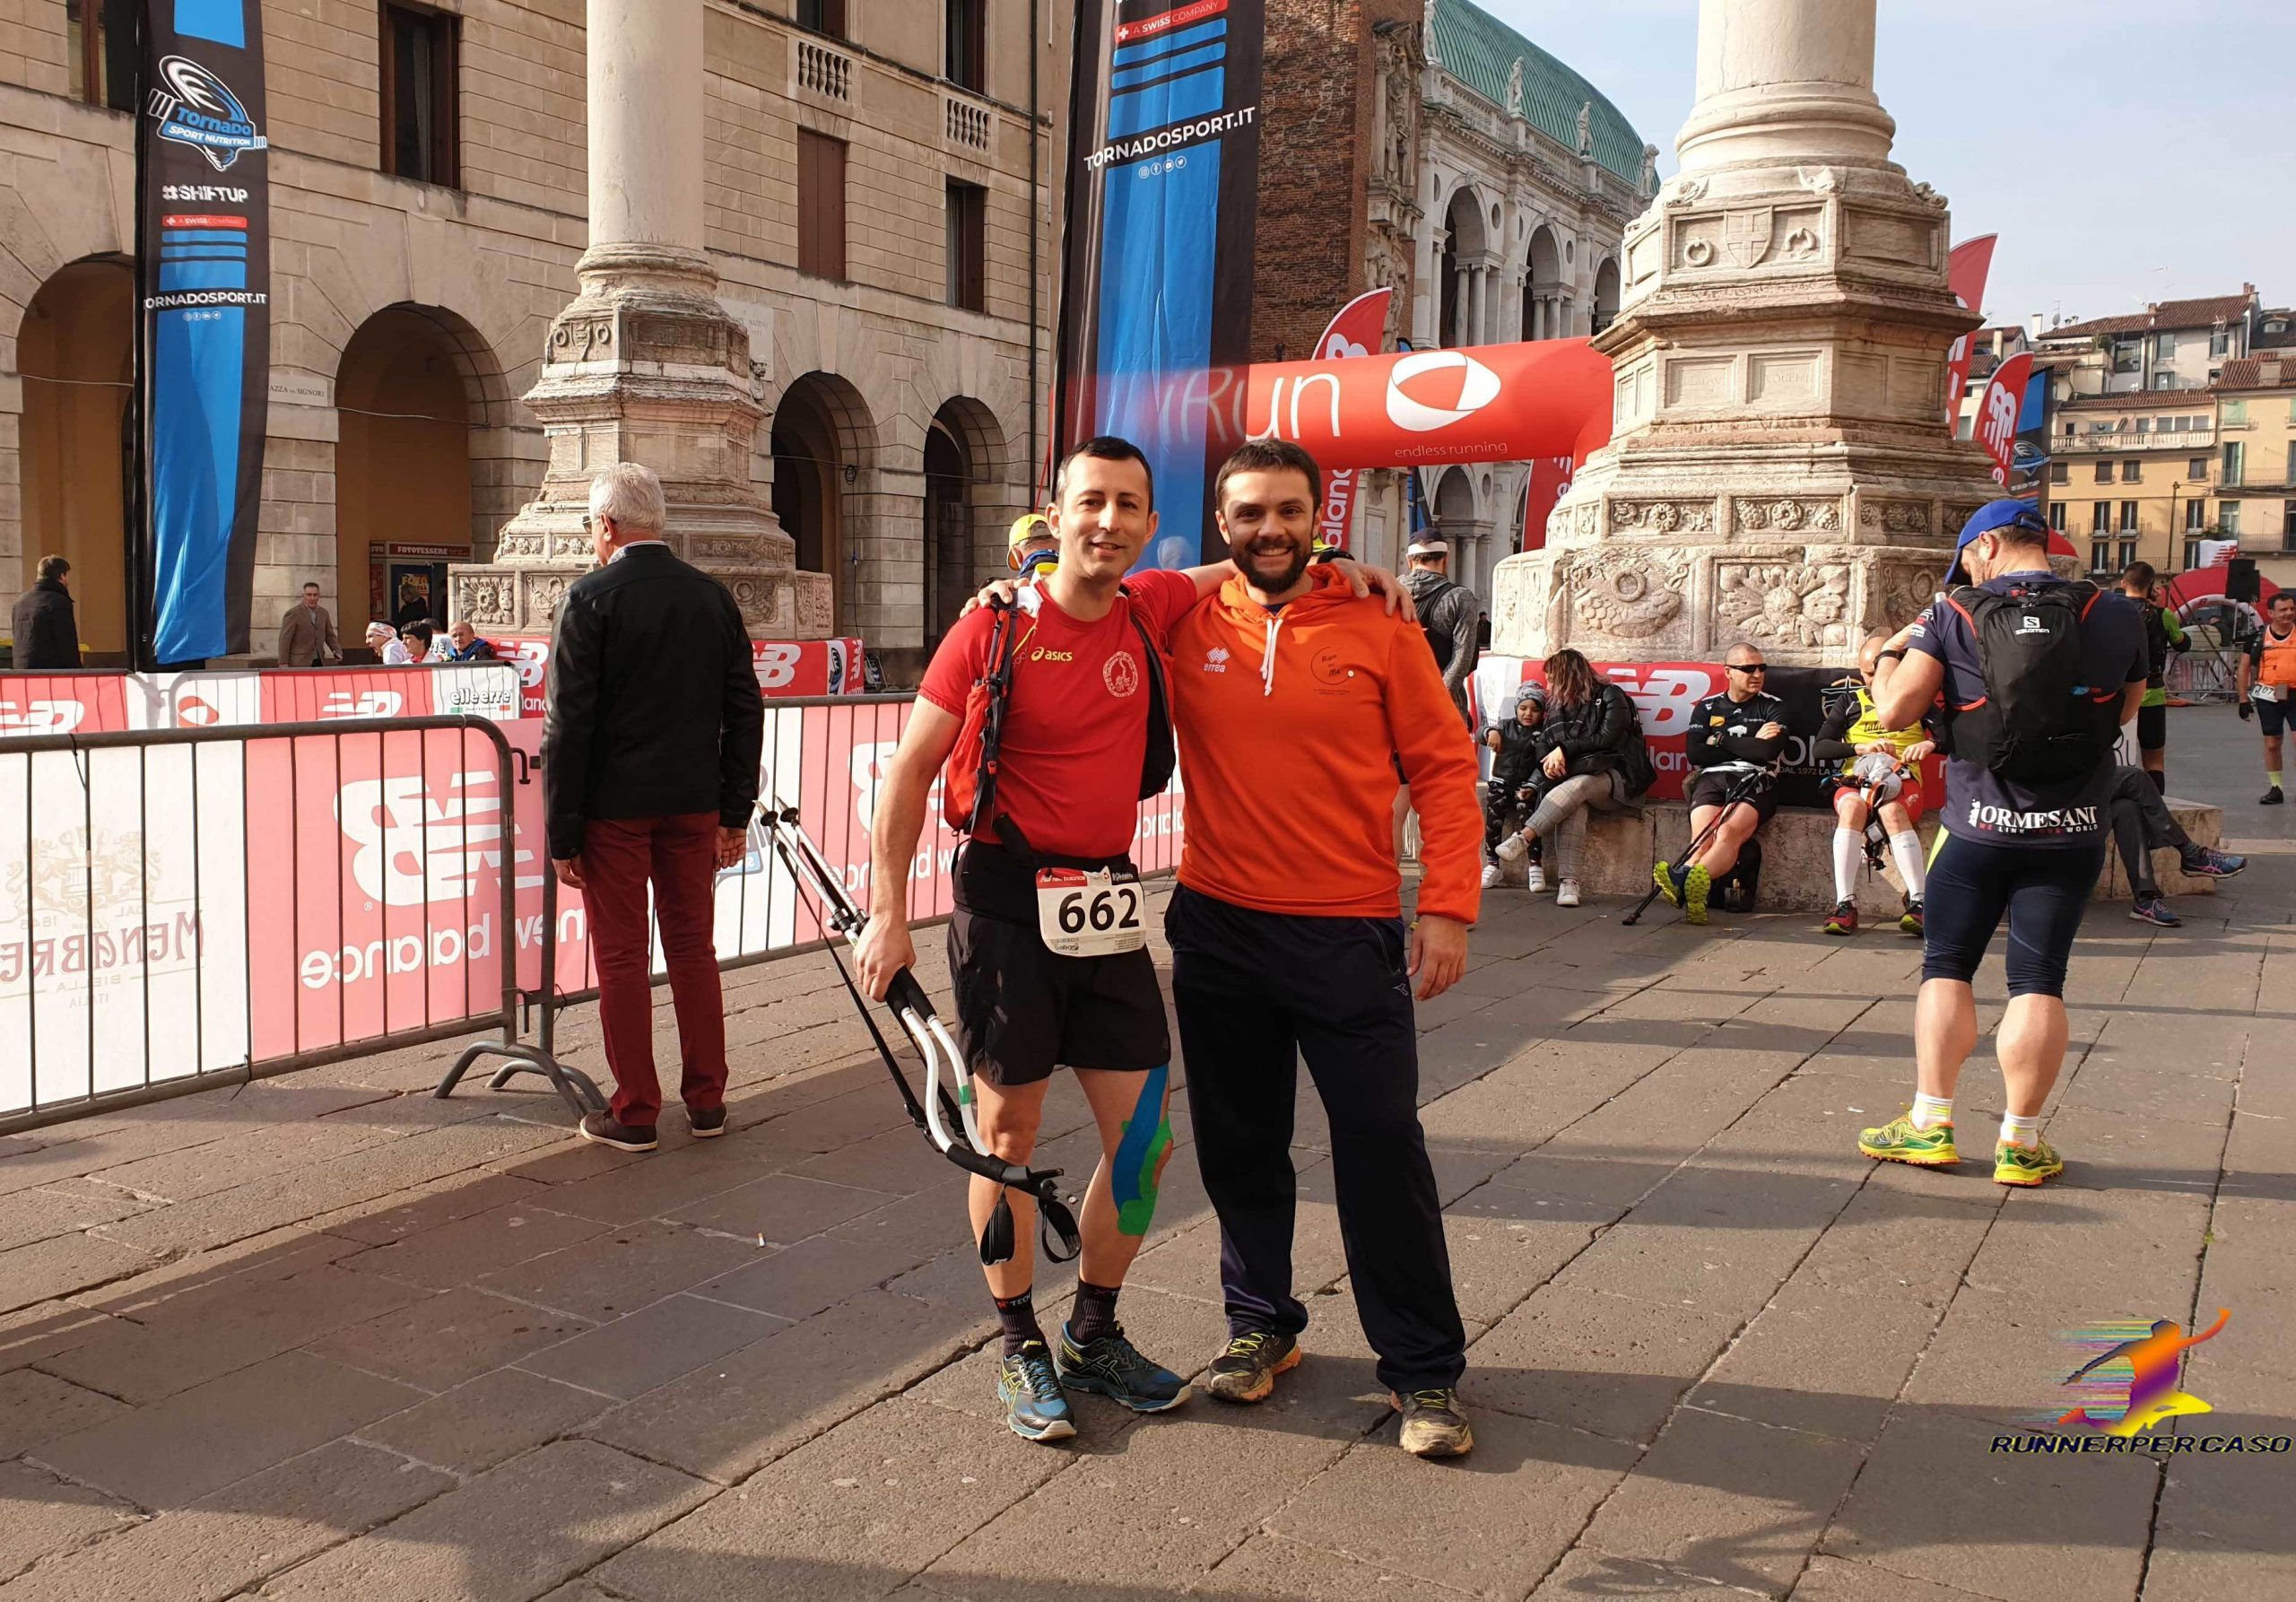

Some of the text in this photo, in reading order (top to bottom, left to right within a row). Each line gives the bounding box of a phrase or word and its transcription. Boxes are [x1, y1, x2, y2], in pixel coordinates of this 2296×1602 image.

[1142, 15, 1171, 33] SWISS
[1171, 1, 1219, 22] COMPANY
[168, 125, 251, 146] SPORT NUTRITION
[1083, 106, 1256, 171] TORNADOSPORT.IT
[161, 185, 248, 203] #SHIFTUP
[297, 387, 325, 397] SIGNORI
[1394, 440, 1508, 459] endless running
[450, 687, 511, 705] elleerre
[1058, 887, 1140, 934] 662
